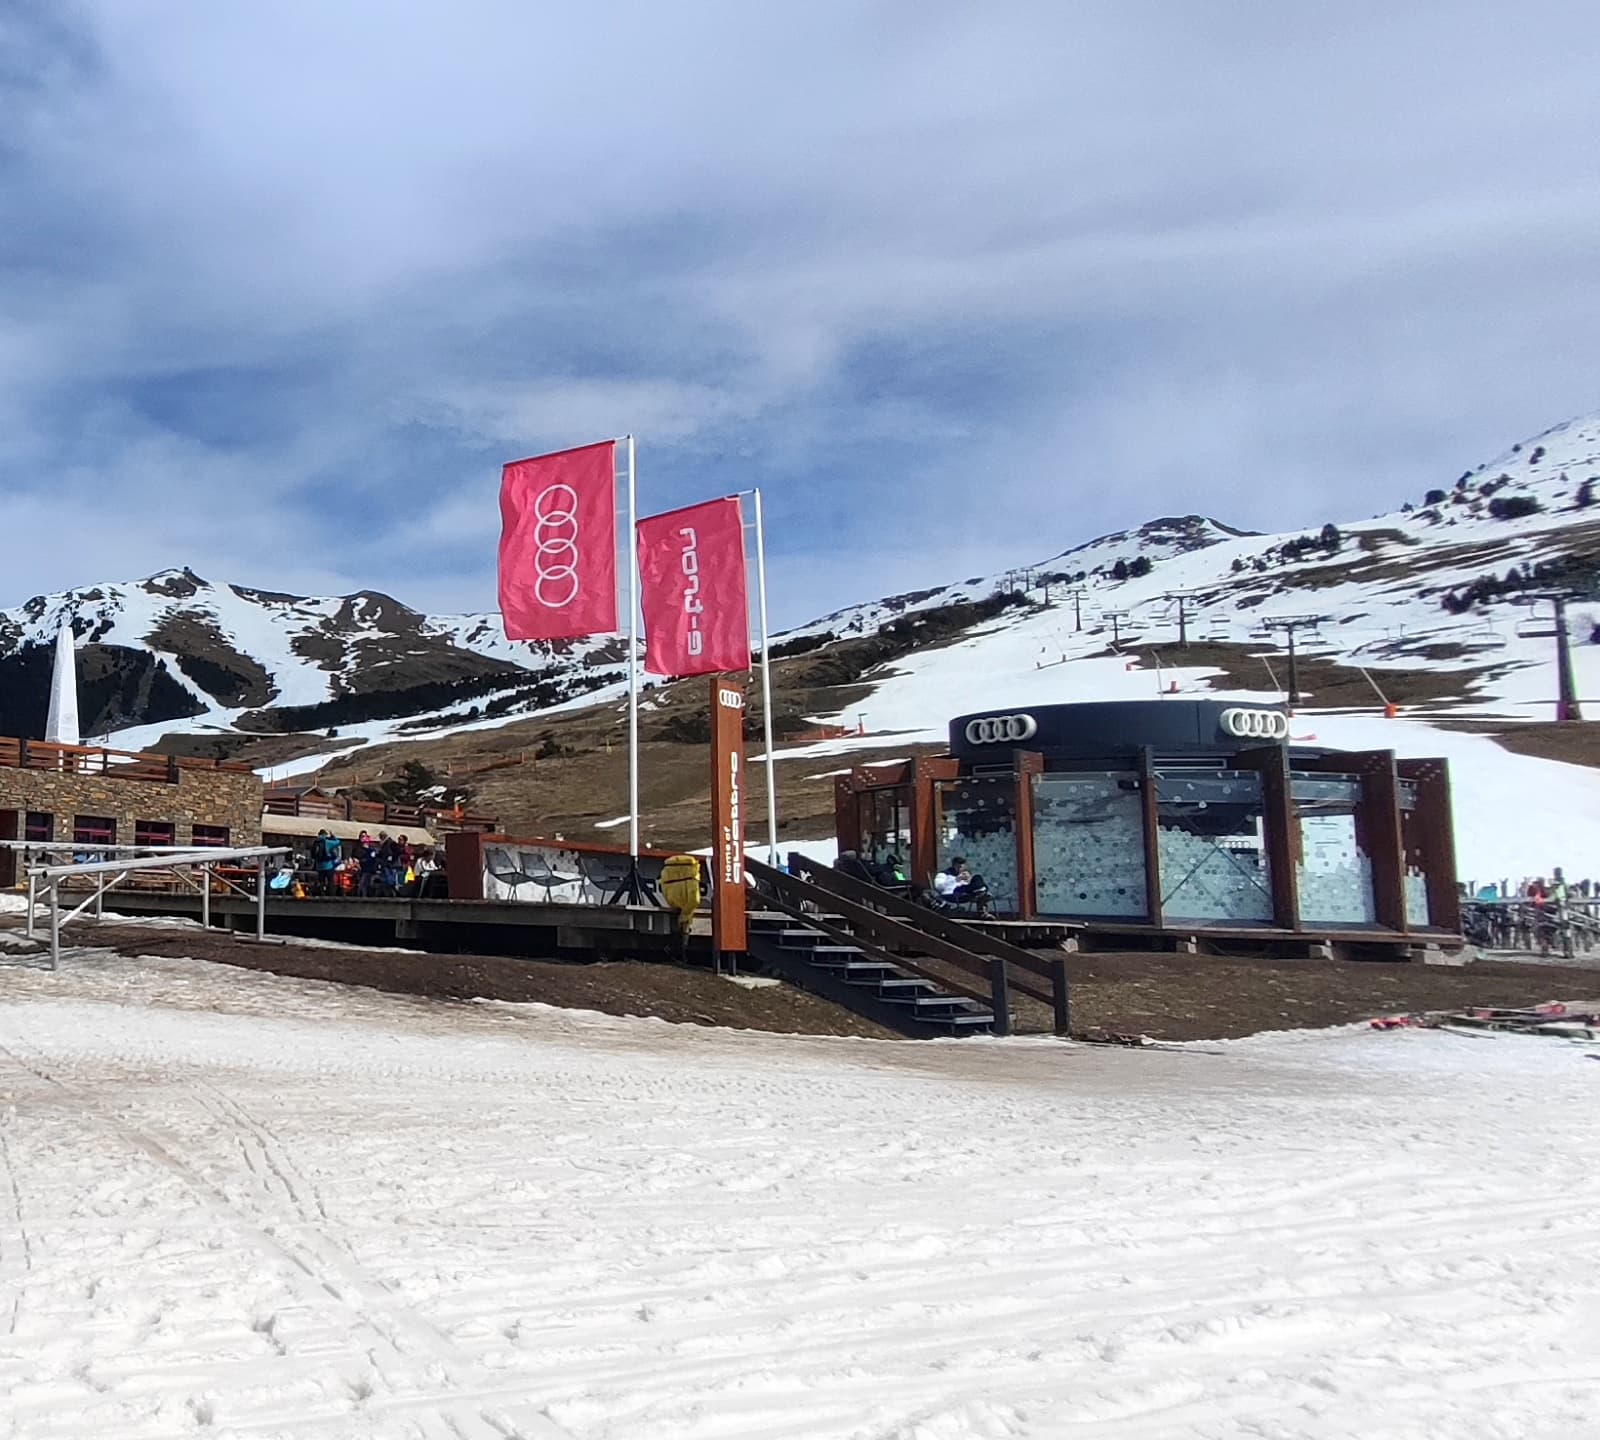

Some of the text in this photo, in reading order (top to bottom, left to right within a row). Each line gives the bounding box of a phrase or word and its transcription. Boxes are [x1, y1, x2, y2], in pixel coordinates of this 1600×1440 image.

[723, 826, 732, 883] Home of
[730, 751, 741, 884] quattro
